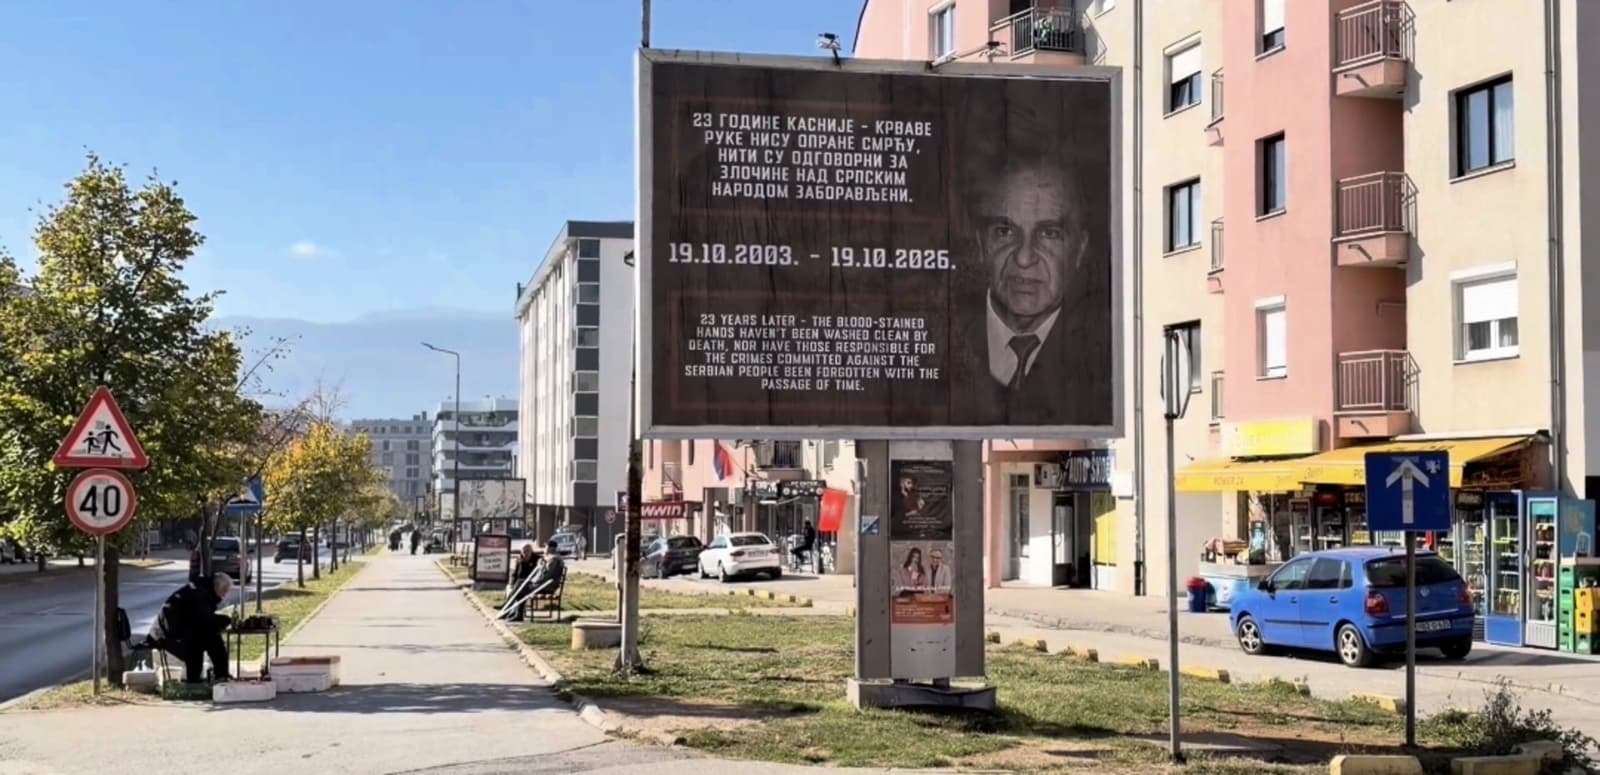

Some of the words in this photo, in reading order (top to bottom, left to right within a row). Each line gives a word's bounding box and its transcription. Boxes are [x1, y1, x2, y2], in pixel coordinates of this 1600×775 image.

[693, 113, 712, 127] 23
[719, 113, 780, 130] ГОДИНЕ
[787, 116, 854, 133] КАСНИЈЕ
[875, 120, 932, 136] КРВАВЕ
[705, 130, 743, 146] РУКЕ
[750, 132, 790, 147] НИСУ
[798, 134, 855, 150] ОПРАНЕ
[862, 136, 920, 154] СМРЋУ,
[718, 150, 757, 163] НИТИ
[764, 151, 784, 164] СУ
[792, 152, 882, 168] ОДГОВОРНИ
[890, 154, 908, 169] ЗА
[720, 165, 789, 181] ЗЛОЧИНЕ
[796, 167, 828, 184] НАД
[835, 169, 906, 185] СРПСКИМ
[712, 181, 788, 199] НАРОДОМ
[796, 184, 913, 202] ЗАБОРАВЉЕНИ.
[669, 243, 799, 265] 19.10.2003.
[831, 247, 956, 270] 19.10.2026.
[700, 314, 715, 325] 23
[720, 314, 757, 326] YEARS
[762, 315, 795, 326] LATER
[812, 316, 832, 327] THE
[837, 316, 925, 329] BLOOD-STAINED
[697, 327, 735, 338] HANDS
[739, 327, 786, 338] HAVEN'T
[792, 328, 819, 340] BEEN
[823, 329, 869, 341] WASHED
[874, 329, 909, 341] CLEAN
[914, 330, 928, 341] BY
[689, 339, 729, 352] DEATH,
[734, 340, 756, 351] NOR
[762, 341, 790, 352] HAVE
[796, 341, 830, 352] THOSE
[835, 341, 909, 354] RESPONSIBLE
[914, 343, 935, 354] FOR
[705, 352, 726, 364] THE
[731, 352, 773, 364] CRIMES
[777, 353, 842, 365] COMMITTED
[846, 354, 895, 366] AGAINST
[900, 355, 919, 367] THE
[685, 365, 734, 377] SERBIAN
[738, 365, 778, 377] PEOPLE
[784, 366, 812, 377] BEEN
[816, 366, 880, 379] FORGOTTEN
[884, 368, 914, 379] WITH
[919, 368, 939, 379] THE
[761, 378, 811, 390] PASSAGE
[816, 379, 829, 390] OF
[836, 379, 865, 391] TIME.
[80, 485, 121, 516] 40
